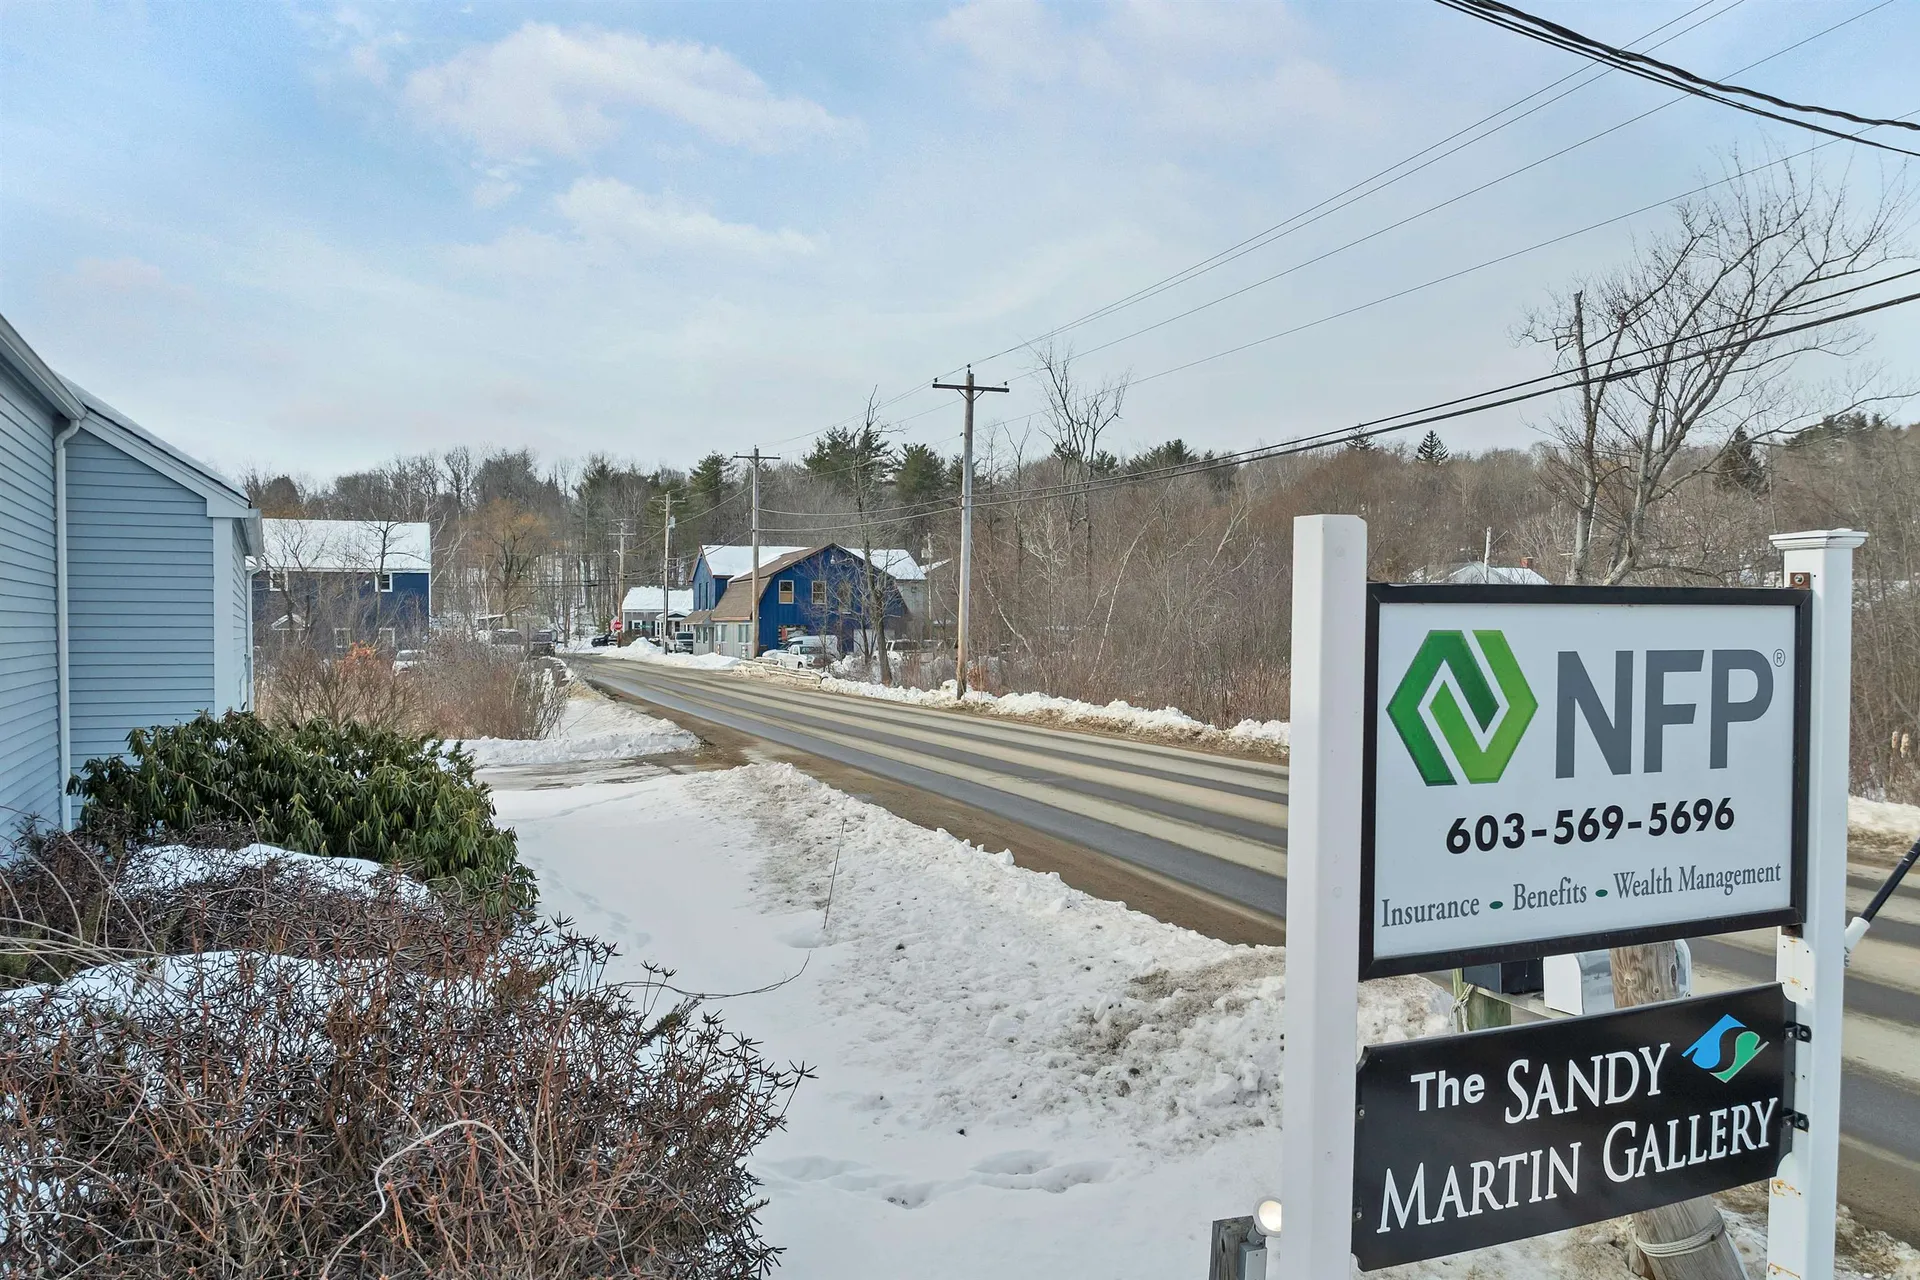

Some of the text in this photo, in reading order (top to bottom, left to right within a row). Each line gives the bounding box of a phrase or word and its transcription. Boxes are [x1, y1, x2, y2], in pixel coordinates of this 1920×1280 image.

[1446, 797, 1735, 854] 603-569-5696
[1381, 862, 1782, 928] Insurance Benefits Wealth Management
[1410, 1042, 1671, 1125] The SANDY
[1376, 1097, 1779, 1235] MARTIN GALLERY
